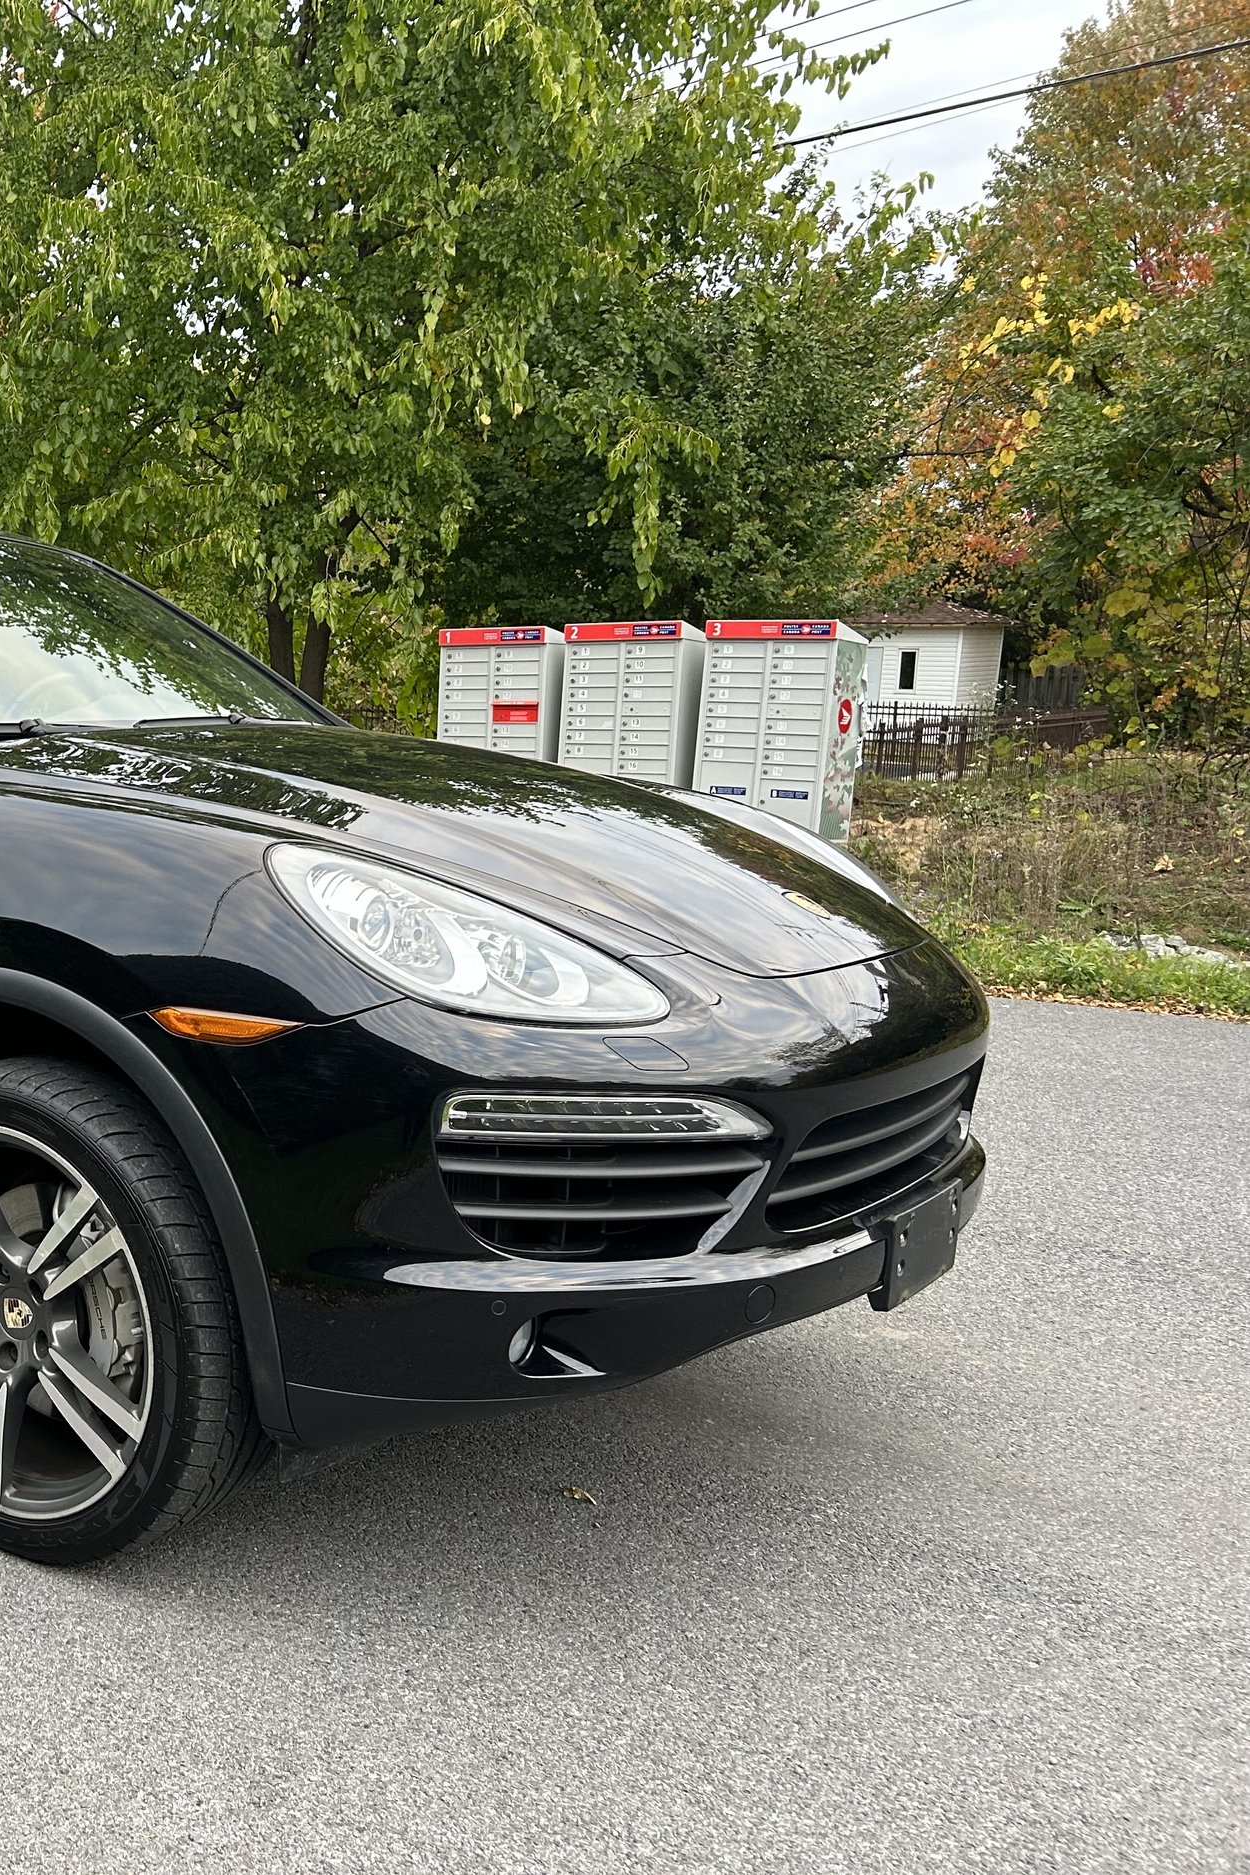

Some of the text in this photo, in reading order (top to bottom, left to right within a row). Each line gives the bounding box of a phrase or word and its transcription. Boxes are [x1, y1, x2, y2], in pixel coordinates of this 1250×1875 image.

[570, 626, 578, 639] 2
[712, 623, 722, 636] 3
[445, 631, 451, 643] 1
[88, 1278, 108, 1340] ORSCHE
